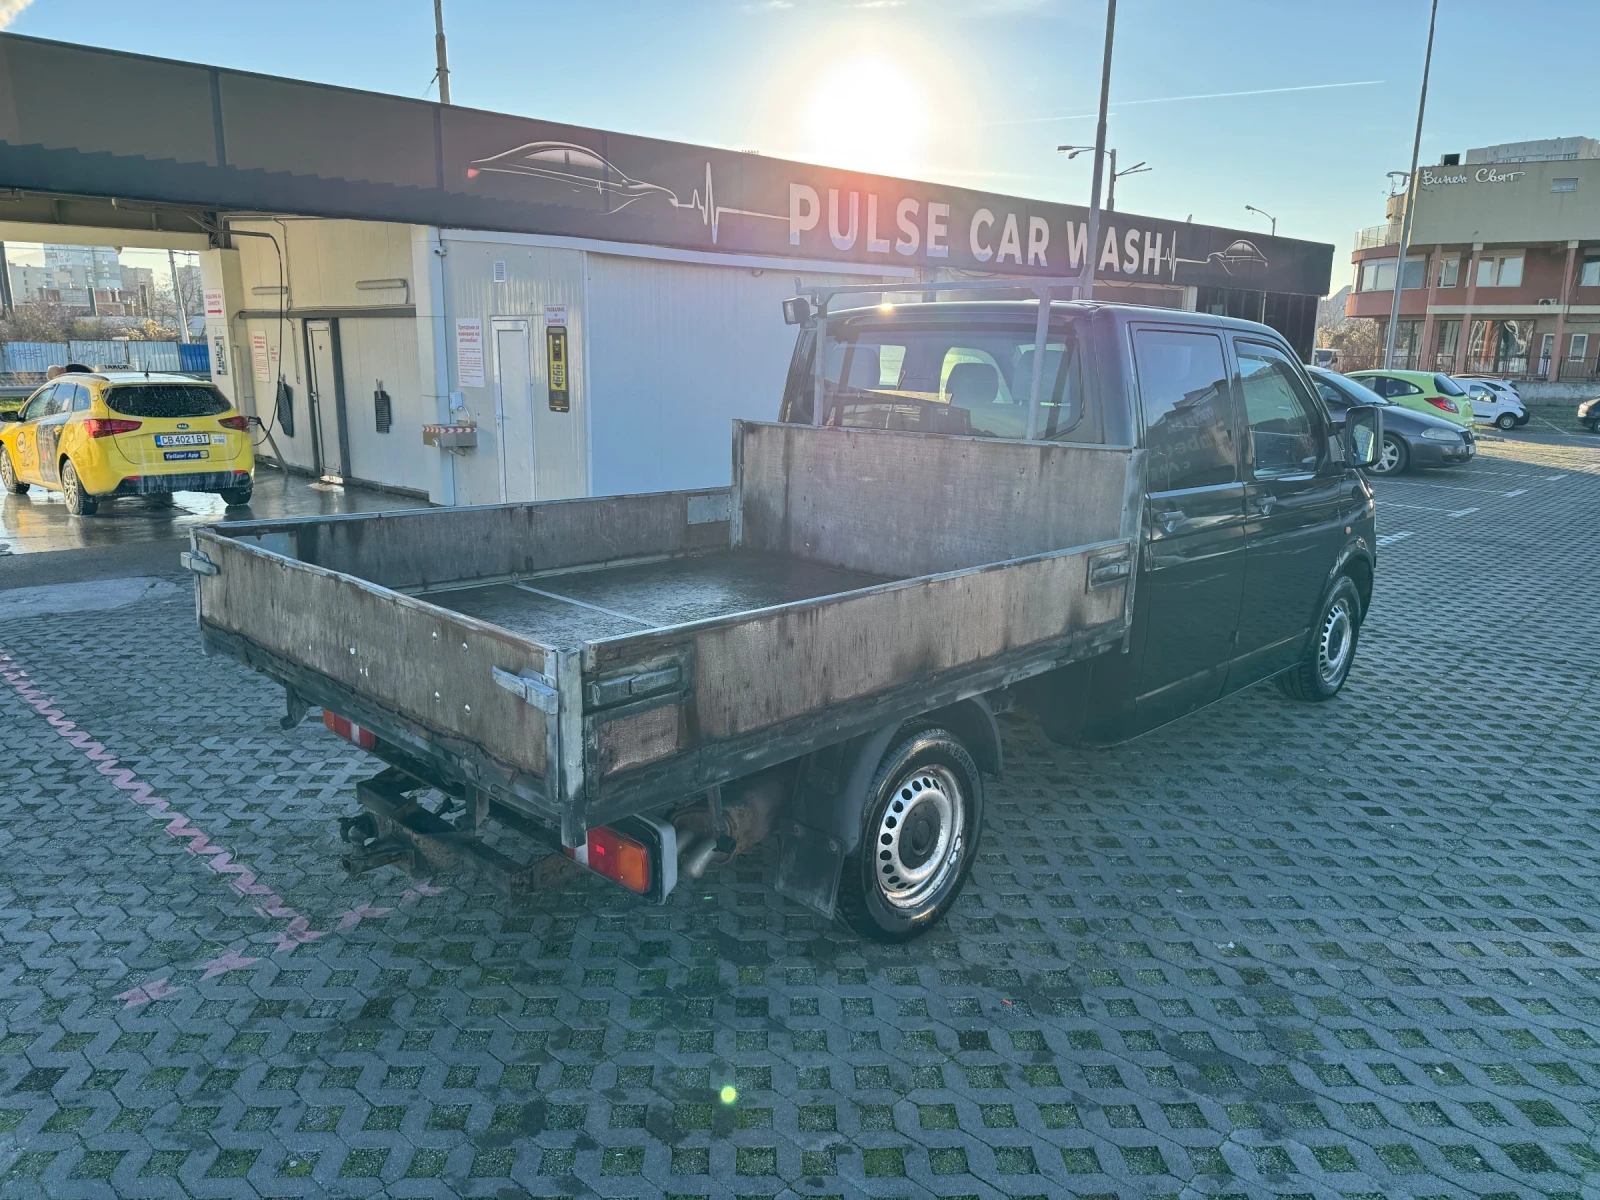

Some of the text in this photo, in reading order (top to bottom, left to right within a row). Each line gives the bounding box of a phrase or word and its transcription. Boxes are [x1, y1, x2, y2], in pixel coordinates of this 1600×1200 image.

[1475, 168, 1526, 183] Свят
[789, 182, 1163, 276] PULSE CAR WASH
